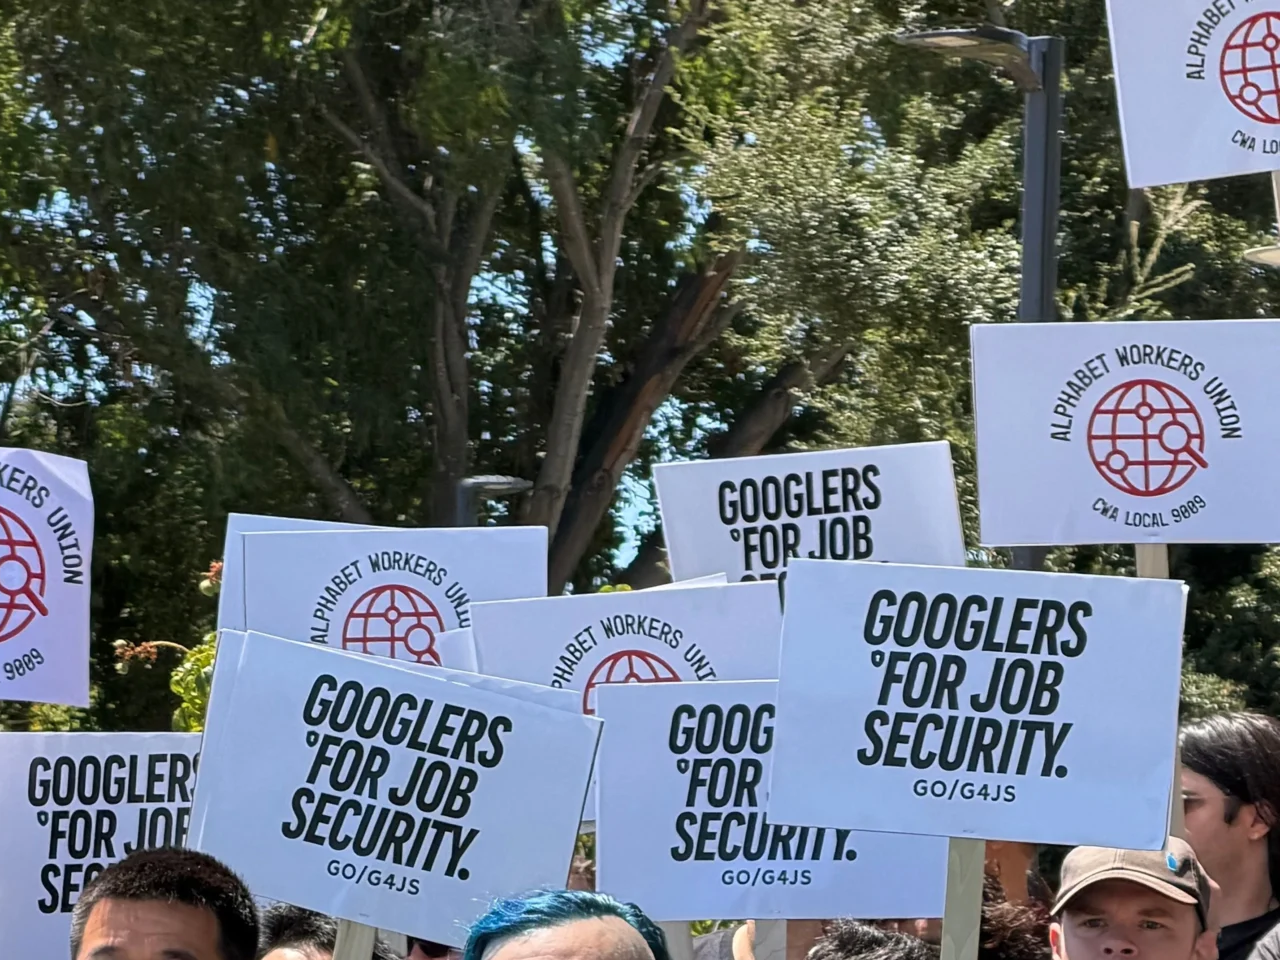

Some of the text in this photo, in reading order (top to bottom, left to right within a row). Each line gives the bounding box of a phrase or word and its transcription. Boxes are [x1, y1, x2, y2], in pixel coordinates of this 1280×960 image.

[1231, 129, 1256, 151] CWA
[1050, 344, 1242, 442] ALPHABET WORKERS UNION
[718, 464, 881, 526] GOOGLERS
[1092, 495, 1206, 527] CWA LOCAL 9009
[47, 506, 84, 585] UNION
[742, 514, 873, 571] FOR JOB
[310, 560, 362, 644] ALPHABET
[368, 551, 447, 586] WORKERS
[863, 589, 1093, 658] GOOGLERS
[4, 648, 45, 681] 9009
[551, 614, 717, 688] PHABET WORKERS UNI
[878, 651, 1065, 716] FOR JOB
[303, 674, 512, 768] GOOGLERS
[668, 703, 775, 754] GOOG
[857, 710, 1074, 779] SECURITY.
[306, 734, 479, 819] FOR JOB
[686, 757, 763, 808] FOR
[913, 779, 1016, 803] GO/G4JS
[48, 809, 117, 860] FOR
[281, 787, 480, 881] SECURITY.
[327, 859, 420, 895] GO/G4JS
[720, 869, 812, 886] GO/G4JS
